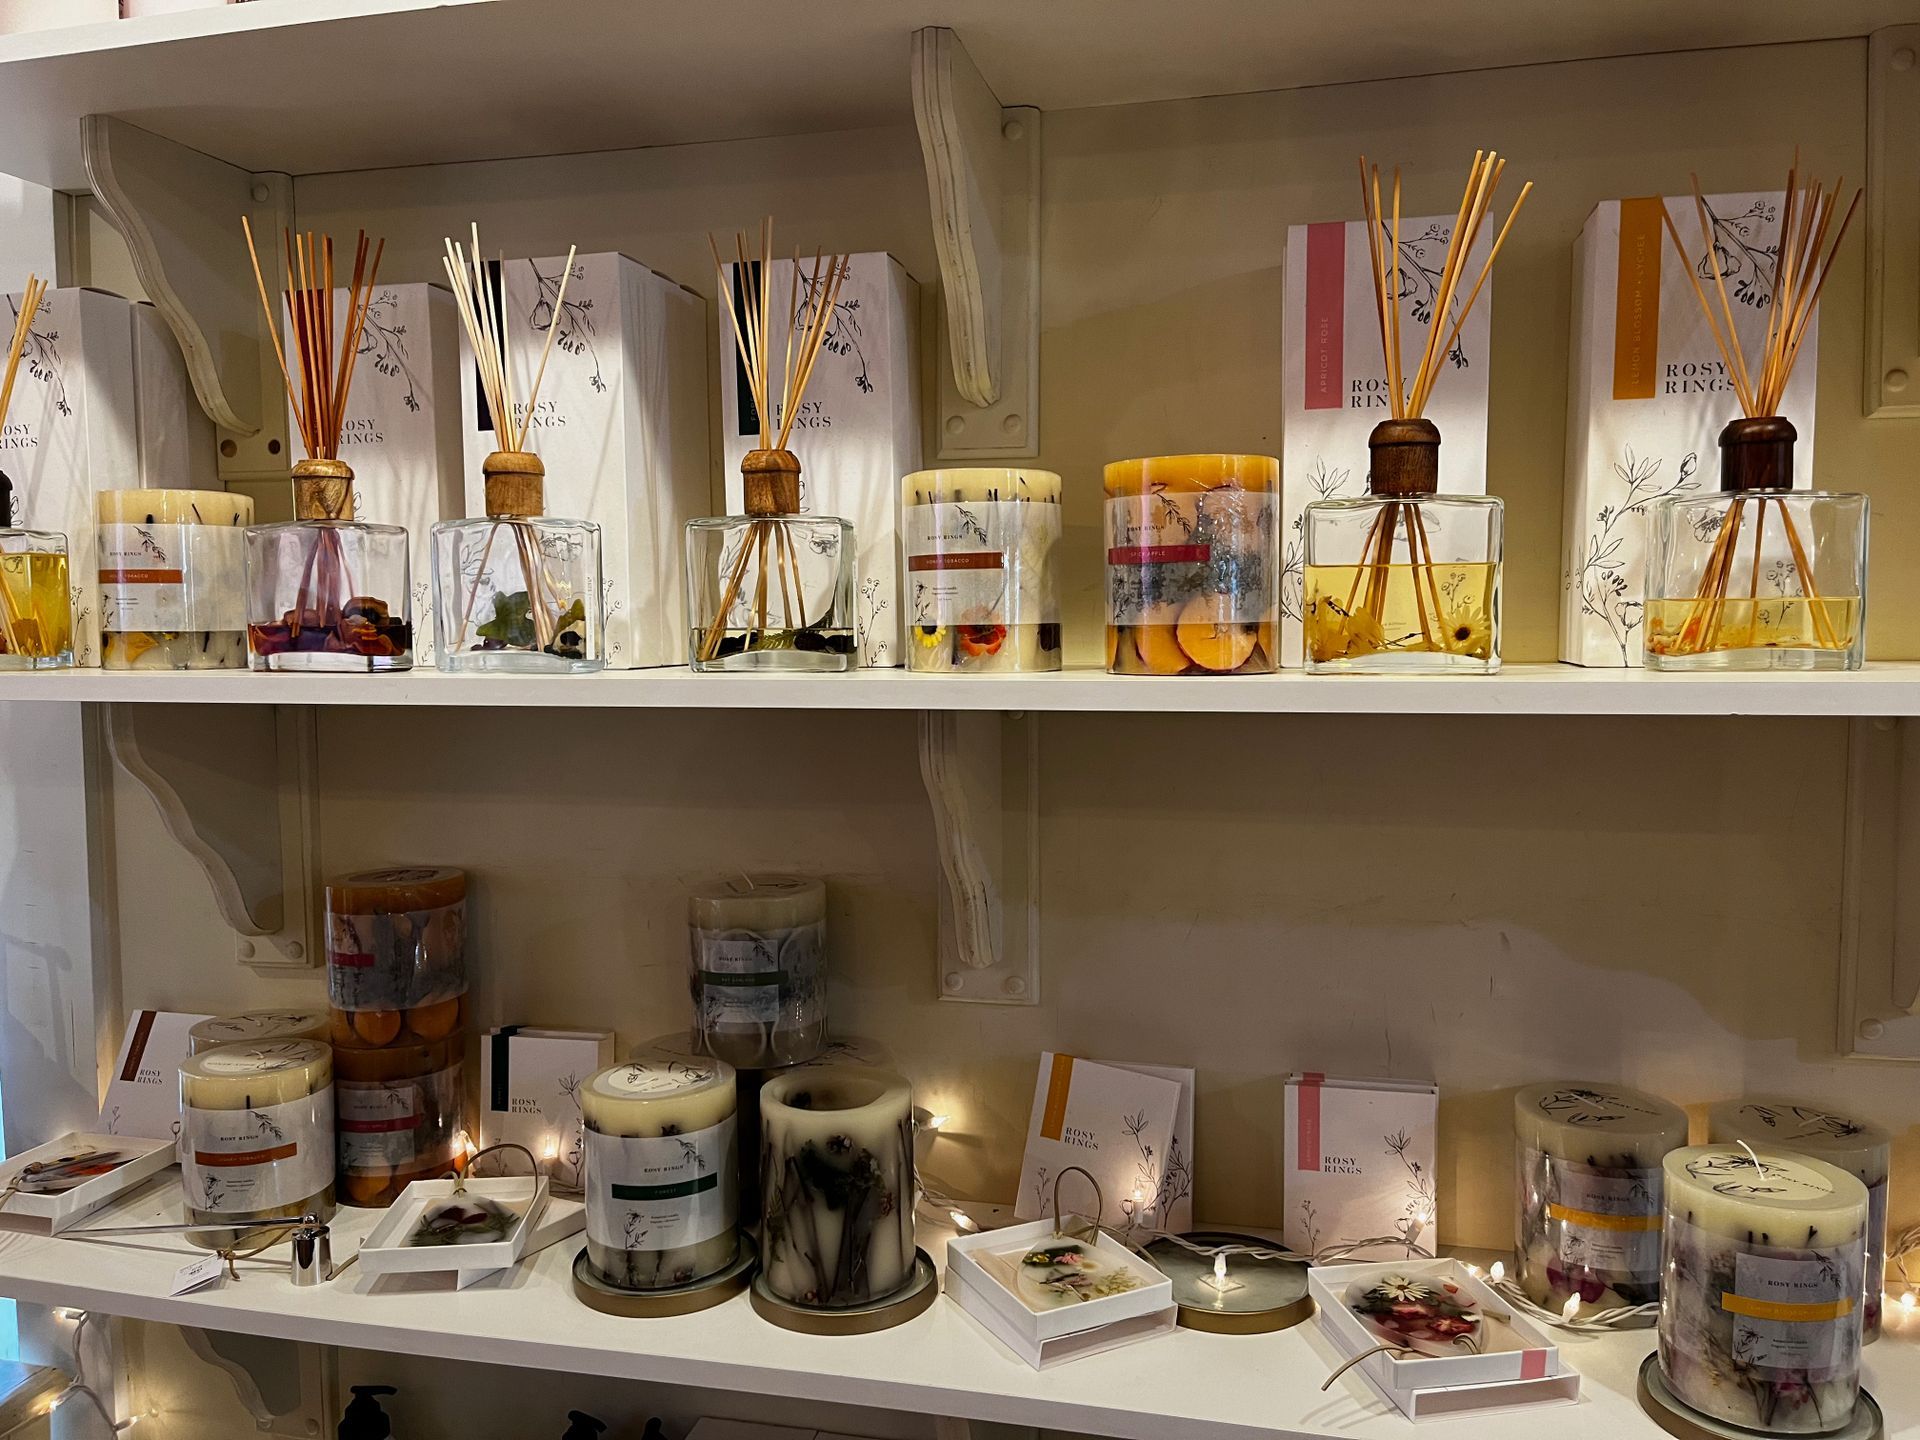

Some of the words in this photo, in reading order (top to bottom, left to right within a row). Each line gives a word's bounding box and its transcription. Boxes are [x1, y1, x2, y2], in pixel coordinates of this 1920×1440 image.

[1633, 291, 1643, 342] BLOSSOM
[1320, 318, 1329, 345] ROSE
[1320, 349, 1329, 394] APRICOT
[1631, 346, 1641, 385] LEMON
[1666, 362, 1728, 377] ROSY
[511, 1098, 537, 1106] ROSY
[511, 1106, 542, 1114] RINGS
[1065, 1126, 1096, 1141] ROSY
[1064, 1135, 1099, 1151] RINGS
[1324, 1155, 1356, 1166] ROSY
[1324, 1165, 1362, 1175] RINGS
[1767, 1280, 1790, 1288] ROSY
